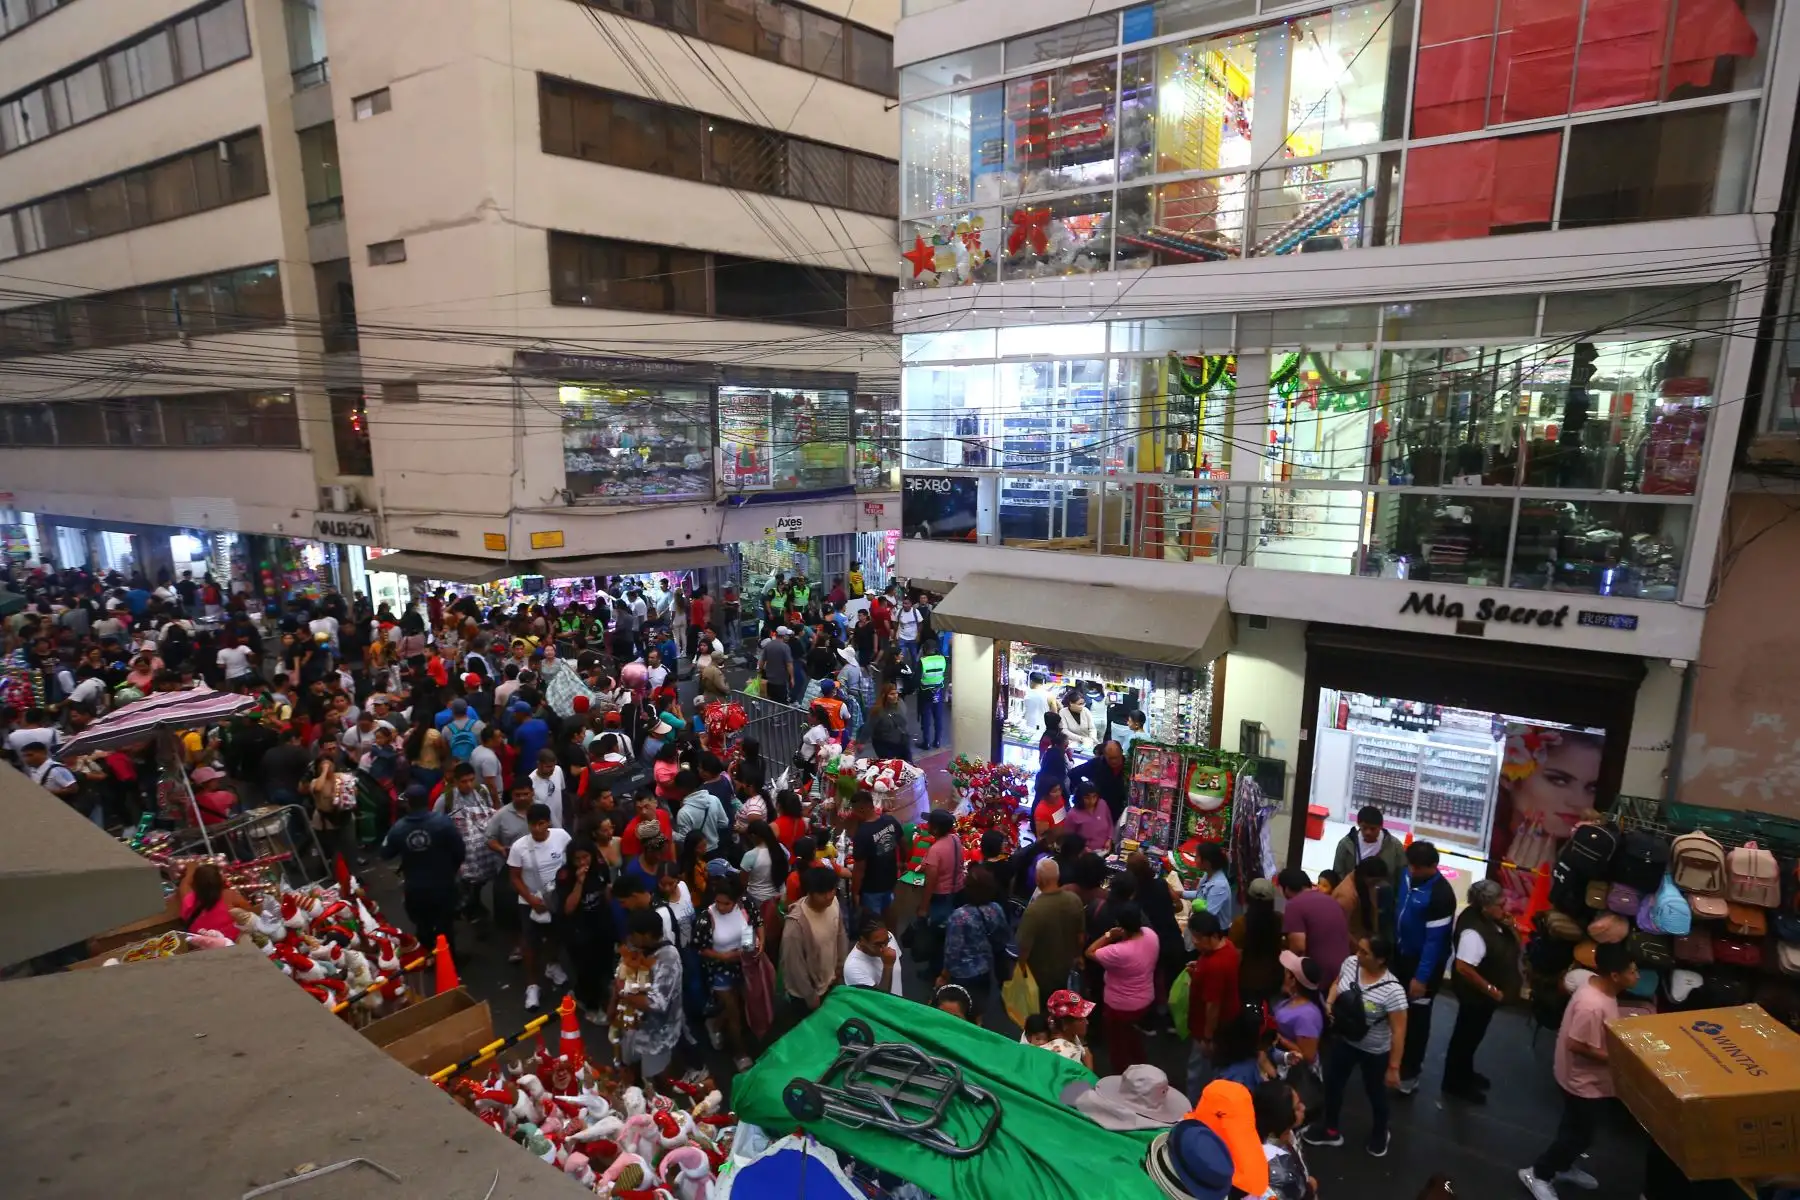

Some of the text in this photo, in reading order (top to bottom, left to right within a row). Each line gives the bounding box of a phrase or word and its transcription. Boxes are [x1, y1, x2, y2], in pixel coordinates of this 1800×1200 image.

[777, 517, 803, 528] Axes
[1400, 592, 1569, 627] Mia Secret
[1713, 1036, 1768, 1077] WINTAS
